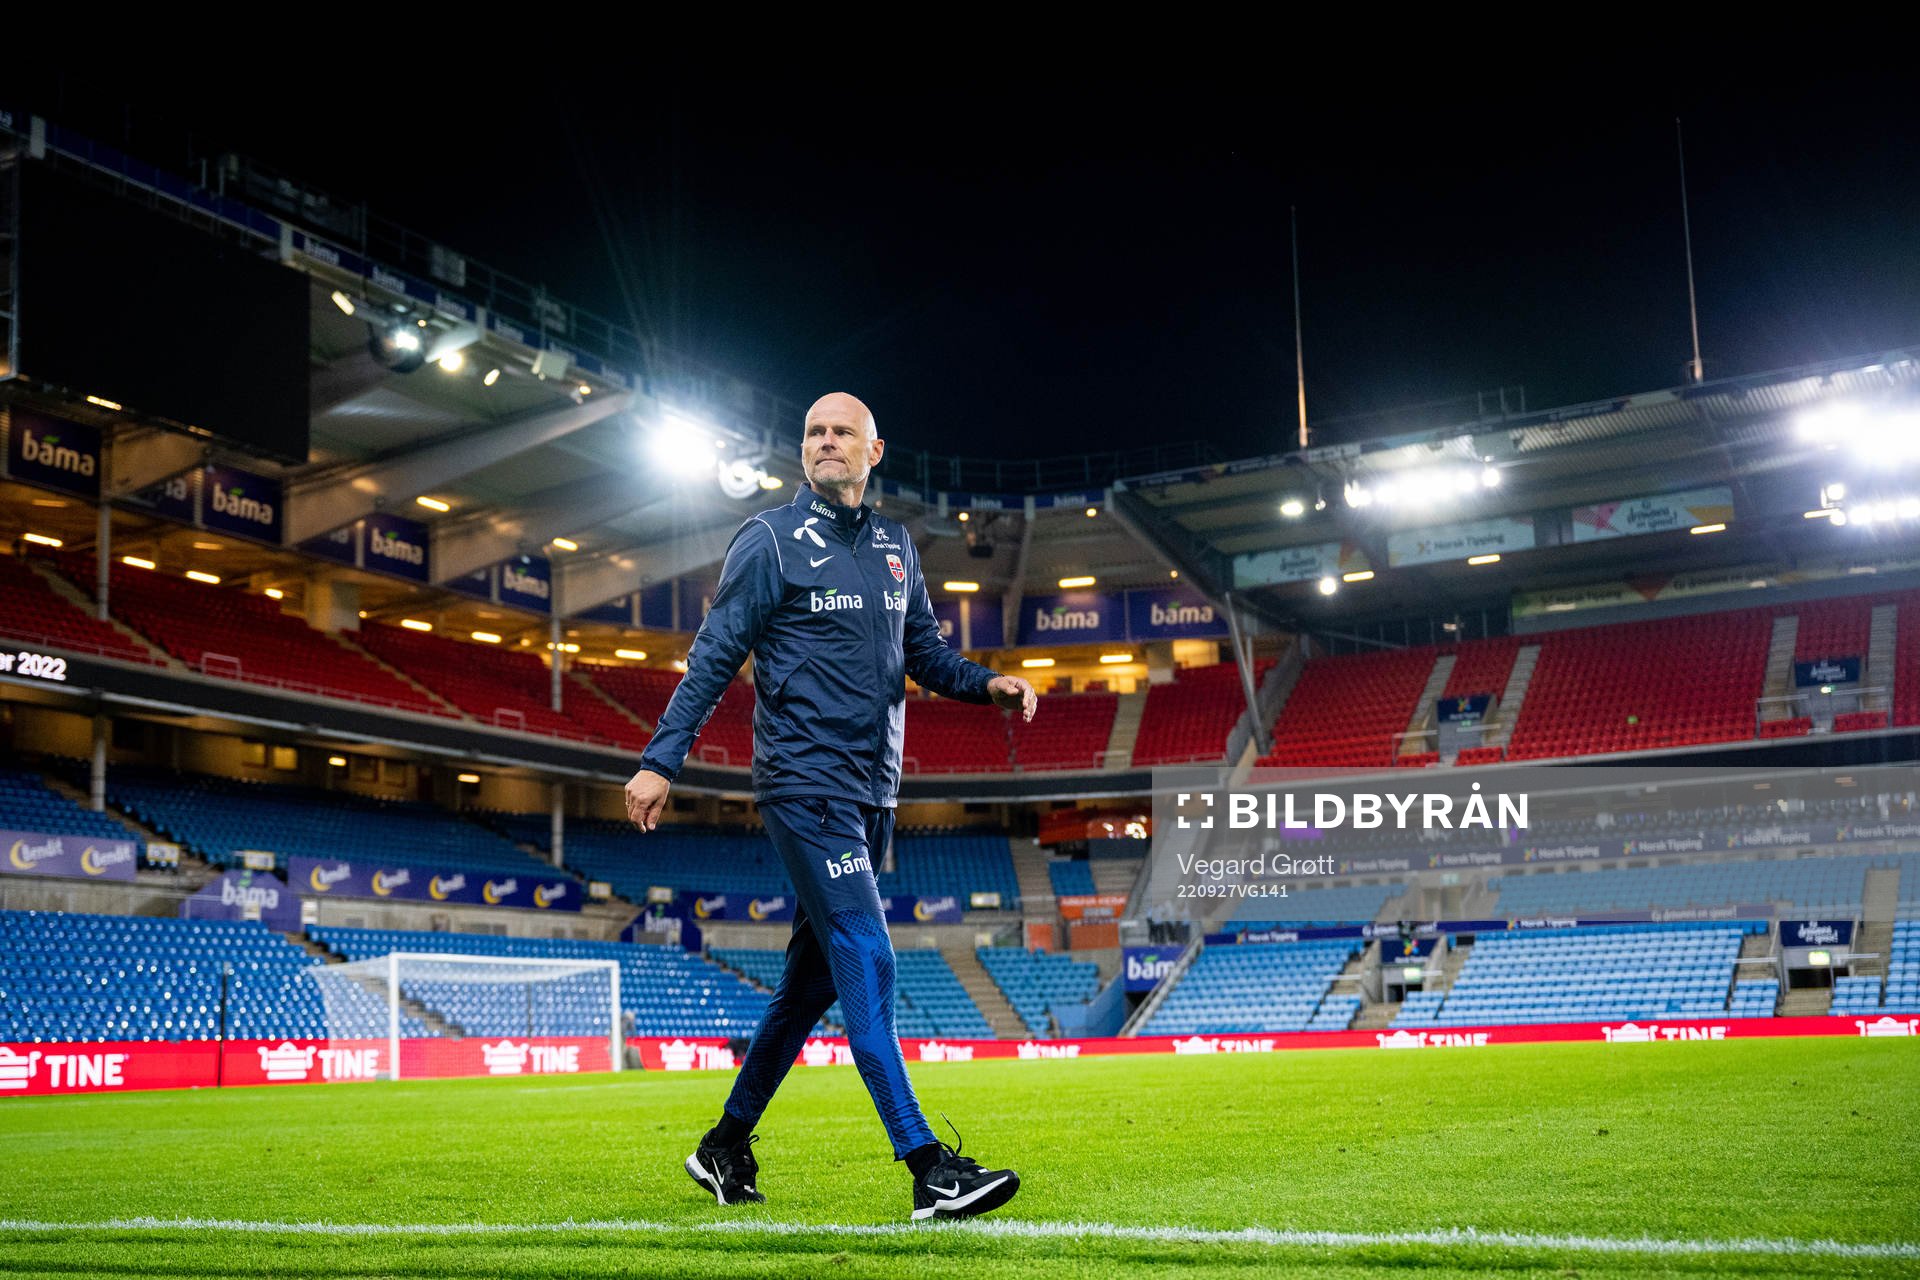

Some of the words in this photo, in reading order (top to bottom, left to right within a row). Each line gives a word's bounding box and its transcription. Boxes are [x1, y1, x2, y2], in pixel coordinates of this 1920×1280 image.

[22, 429, 96, 477] bama
[211, 482, 275, 525] bama
[811, 500, 837, 520] bama
[371, 527, 424, 566] bama
[811, 589, 863, 612] bama
[883, 591, 905, 612] ba
[1151, 602, 1214, 625] bama
[1036, 606, 1100, 631] bama
[17, 651, 67, 681] 2022
[221, 877, 280, 909] bama
[1127, 956, 1178, 980] bam
[45, 1054, 124, 1088] TINE
[317, 1049, 379, 1080] TINE
[530, 1046, 579, 1073] TINE
